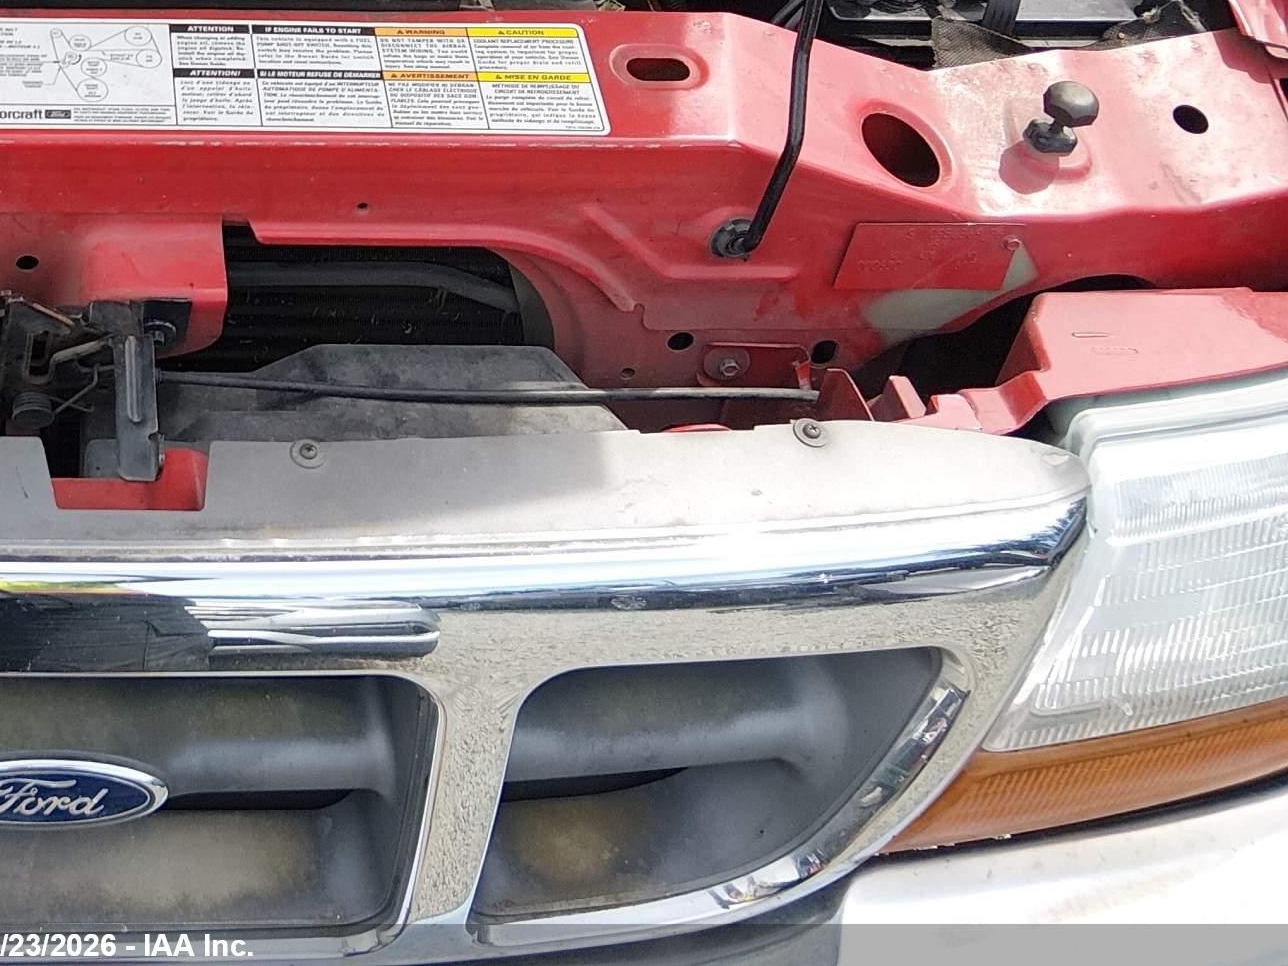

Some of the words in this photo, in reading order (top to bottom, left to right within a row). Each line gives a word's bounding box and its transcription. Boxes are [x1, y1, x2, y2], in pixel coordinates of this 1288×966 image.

[338, 27, 362, 35] START
[276, 70, 306, 78] MOTEUR
[306, 70, 334, 78] REFUSE
